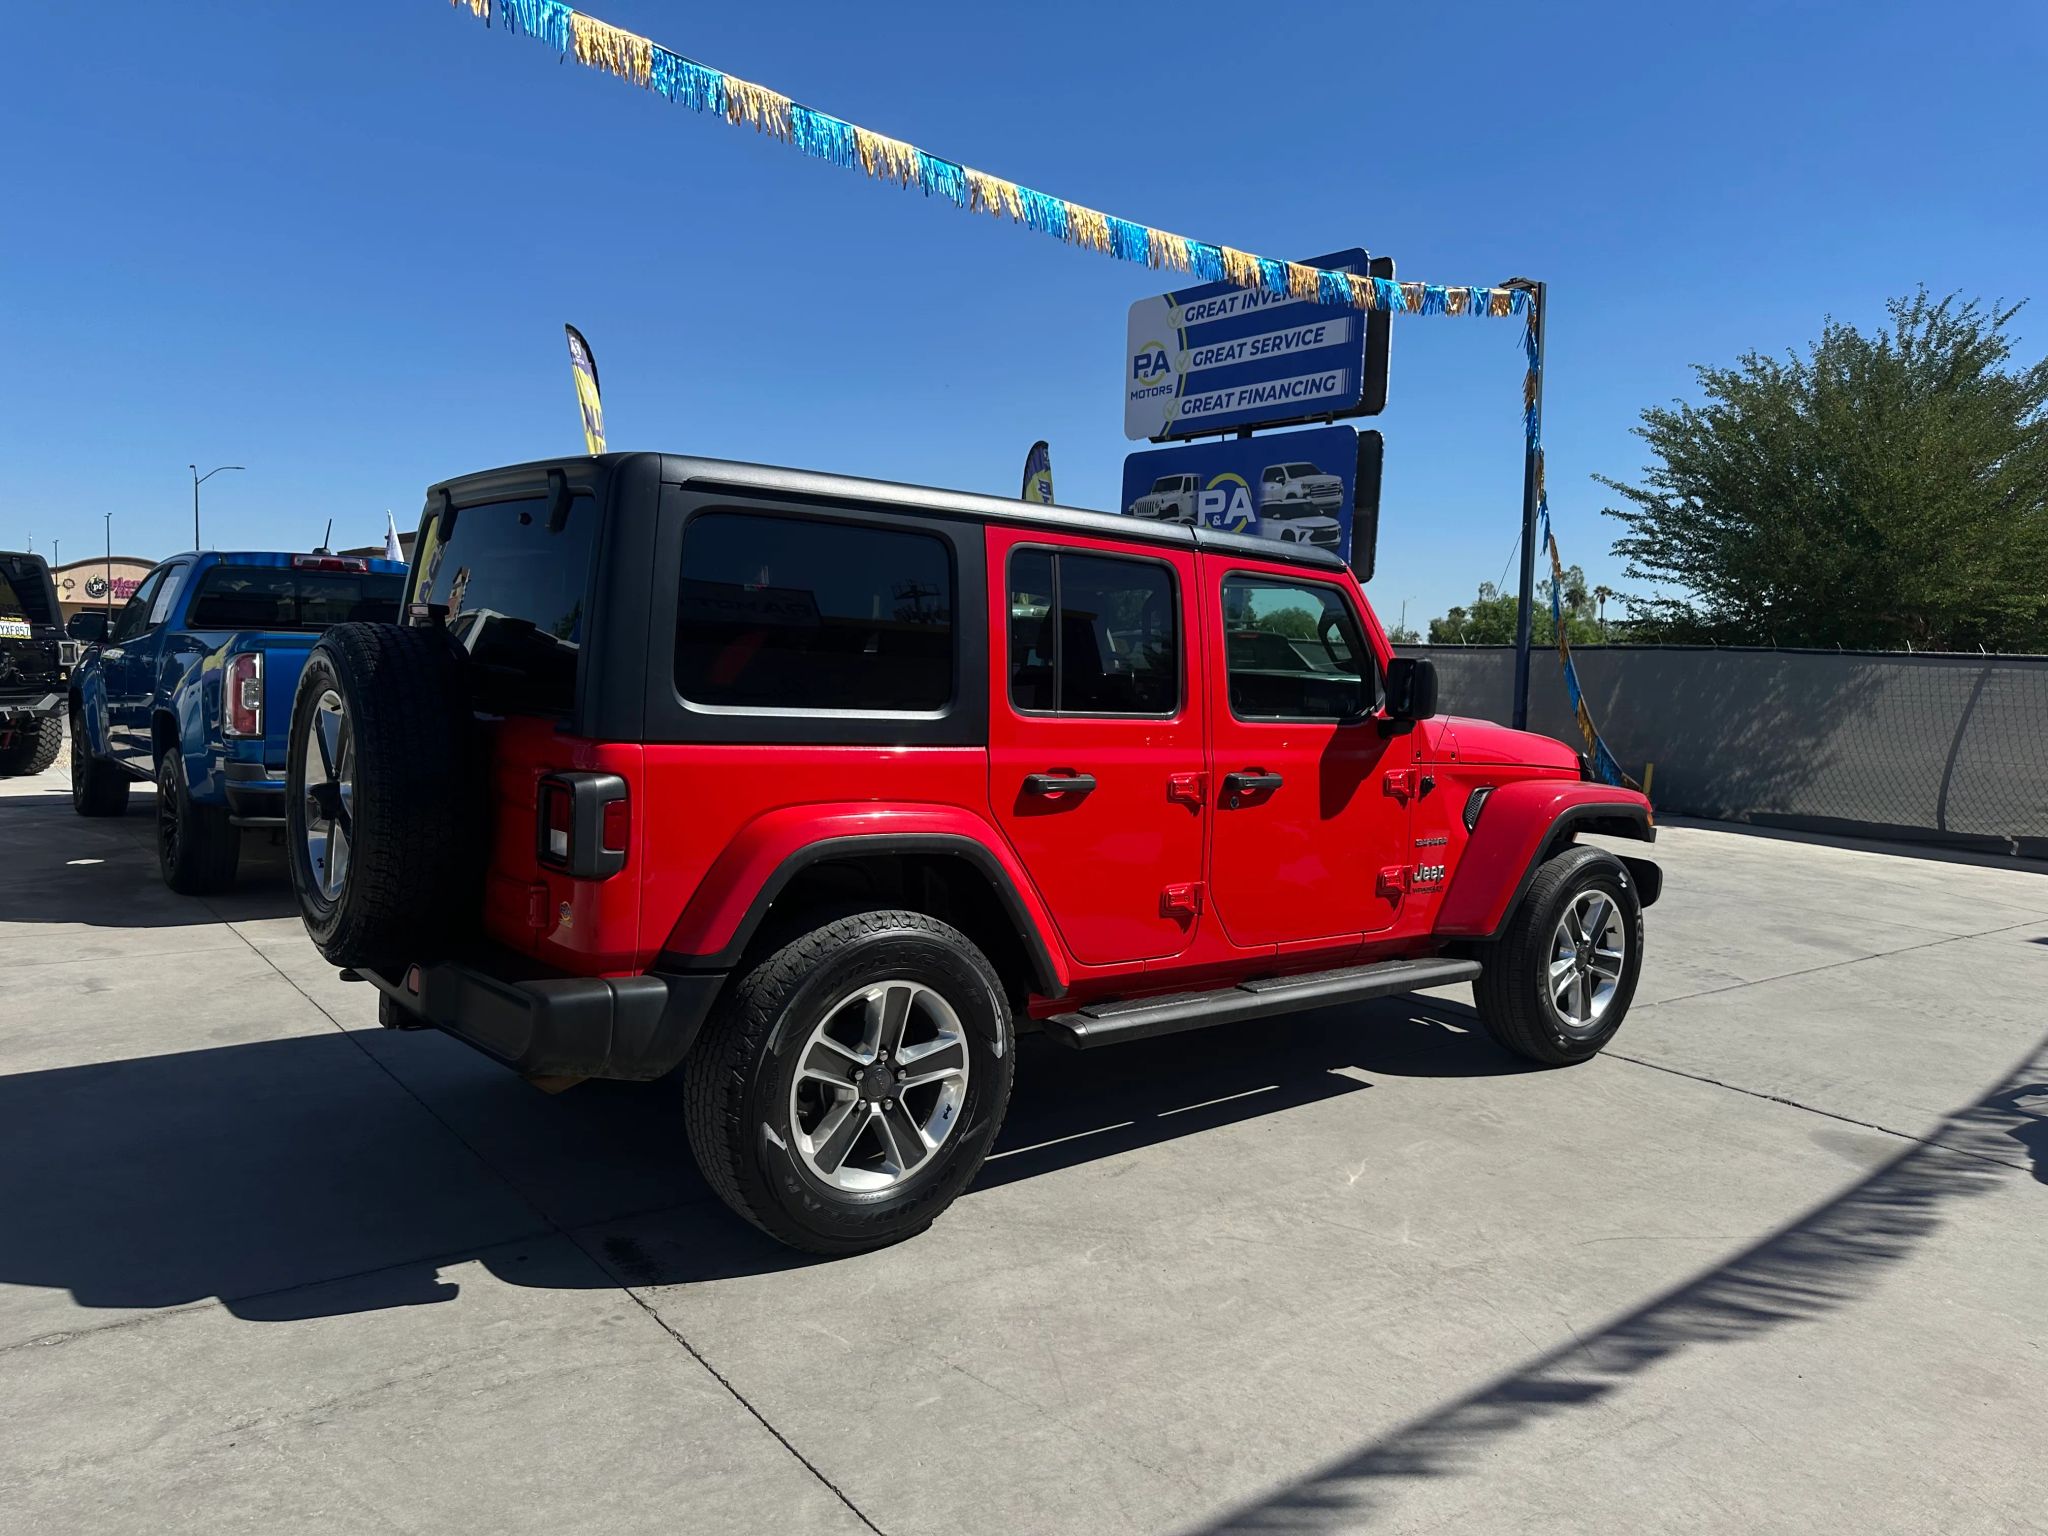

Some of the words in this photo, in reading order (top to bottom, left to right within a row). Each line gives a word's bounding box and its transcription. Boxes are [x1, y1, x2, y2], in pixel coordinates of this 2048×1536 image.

[1184, 296, 1238, 322] GREAT
[1193, 343, 1247, 367] GREAT
[1249, 326, 1325, 356] SERVICE
[1130, 384, 1173, 400] MOTORS
[1181, 391, 1236, 415] GREAT
[1237, 375, 1336, 406] FINANCING
[1413, 863, 1444, 883] Jeep
